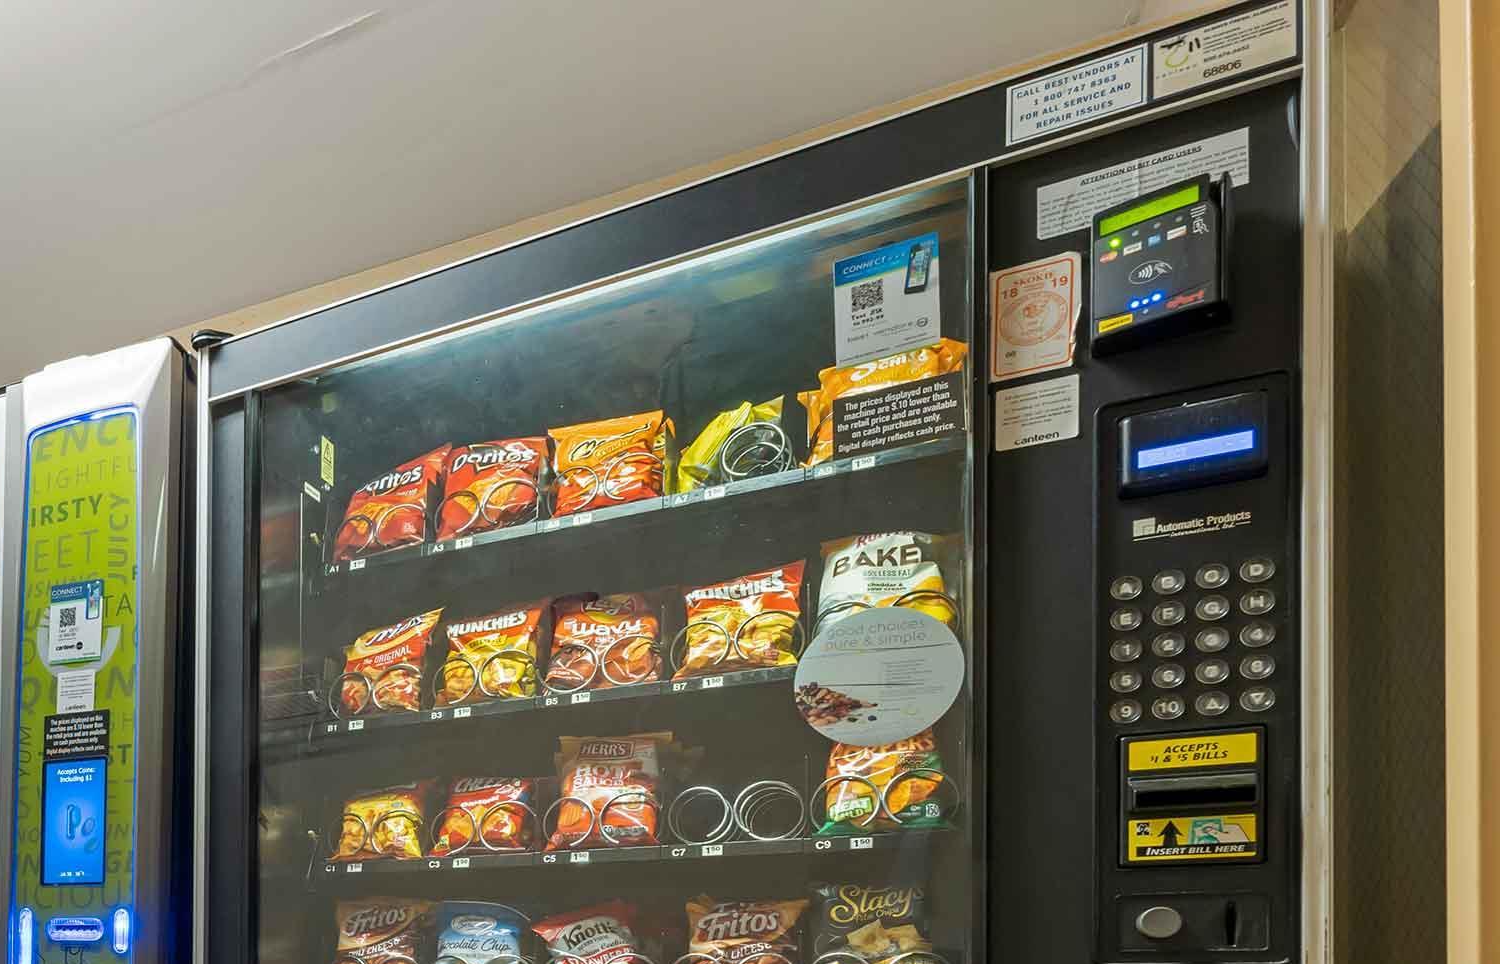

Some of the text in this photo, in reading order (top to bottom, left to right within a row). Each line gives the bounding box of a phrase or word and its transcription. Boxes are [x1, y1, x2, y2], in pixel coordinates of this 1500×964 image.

[1202, 60, 1243, 78] 68806
[1016, 55, 1136, 99] CALL BEST VENDORS AT
[1033, 74, 1117, 106] 1 800 747 8363
[1019, 82, 1132, 123] FOR ALL SERVICE AND
[1036, 100, 1114, 130] REPAIR ISSUES
[1080, 145, 1203, 187] ATTENTION DEBIT CARD USERS
[842, 254, 887, 276] CONNECT
[1051, 275, 1069, 288] 19
[1002, 287, 1018, 300] 18
[845, 381, 949, 412] The prices displayed on this
[843, 406, 877, 421] machine
[877, 404, 890, 413] are
[909, 396, 931, 407] lower
[932, 391, 950, 403] than
[837, 399, 957, 432] the retail price and are available
[851, 429, 861, 438] on
[862, 424, 881, 437] cash
[882, 417, 922, 435] purchases
[838, 440, 861, 453] Digital
[861, 434, 886, 449] display
[887, 430, 914, 442] reflects
[915, 426, 934, 437] cash
[1014, 431, 1060, 446] canteen
[452, 448, 538, 472] Doritos
[1156, 510, 1251, 534] Automatic Products
[432, 543, 444, 552] A3
[52, 585, 83, 597] CONNECT
[684, 569, 784, 604] MUNCHIES
[1120, 582, 1133, 595] A
[1120, 596, 1265, 626] E F G H
[446, 610, 527, 639] MUNCHIES
[1163, 638, 1174, 652] 2
[373, 644, 412, 664] ORIGINAL
[672, 681, 688, 691] B7
[1120, 674, 1132, 686] 5
[545, 697, 558, 706] B5
[430, 711, 443, 720] B3
[1120, 700, 1179, 719] 9 10
[580, 742, 628, 756] HERR'S
[1163, 741, 1220, 754] ACCEPTS
[1162, 753, 1172, 763] &
[1192, 750, 1228, 761] BILLS
[57, 767, 77, 777] Accepts
[60, 774, 85, 783] Including
[672, 848, 686, 857] C7
[815, 840, 831, 850] C9
[1146, 844, 1245, 857] INSERT BILL HERE
[428, 860, 441, 869] C3
[543, 855, 556, 863] C5
[325, 865, 336, 873] C1
[345, 906, 407, 936] Fritos
[699, 910, 779, 941] Fritos
